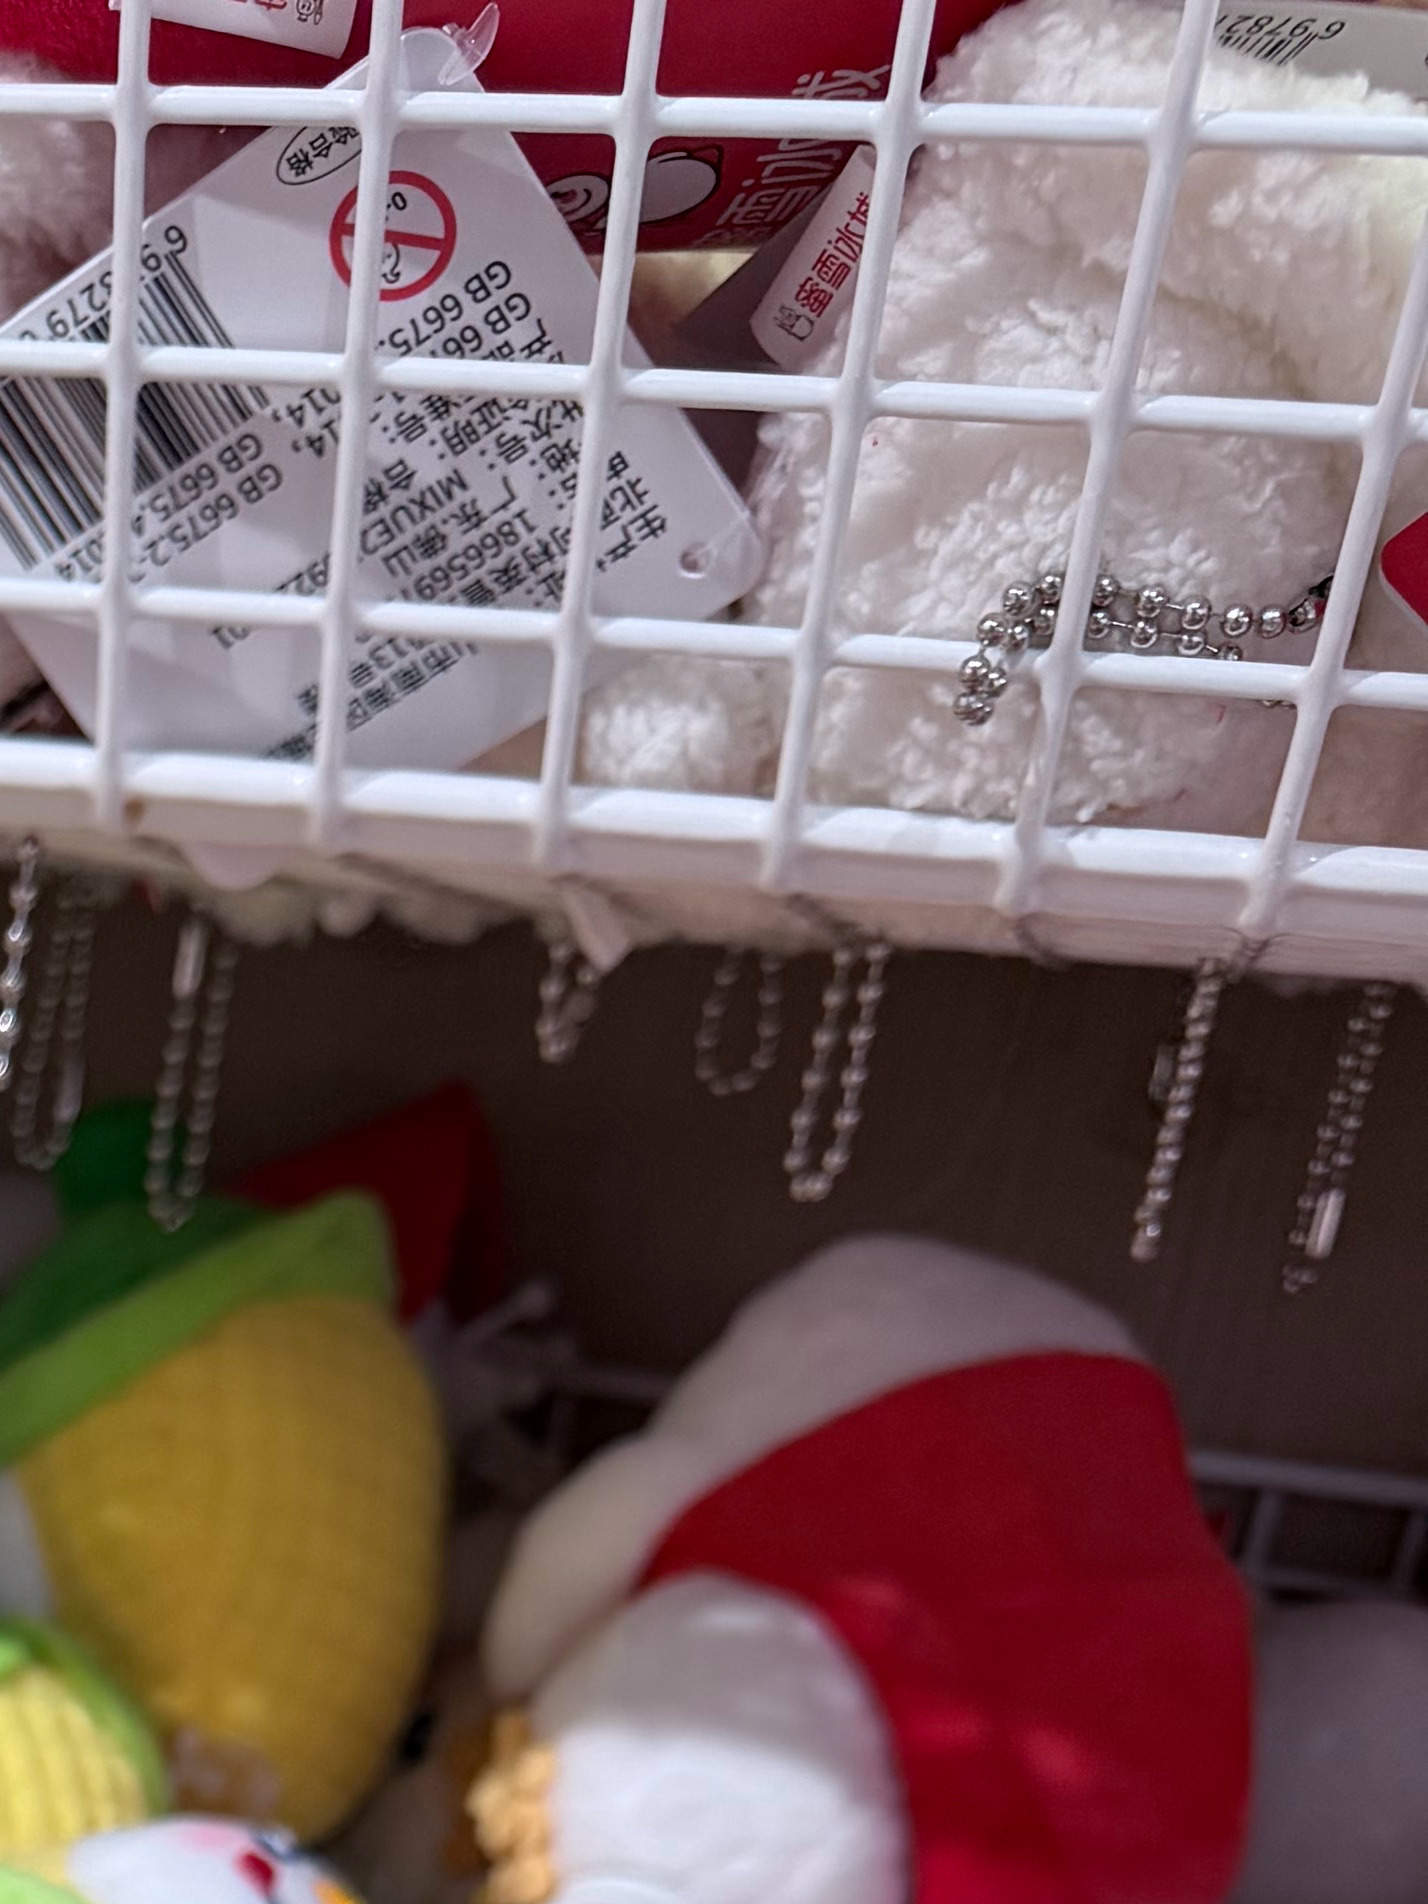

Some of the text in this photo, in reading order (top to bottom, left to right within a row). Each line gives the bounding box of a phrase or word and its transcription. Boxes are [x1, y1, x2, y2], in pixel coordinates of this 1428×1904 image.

[284, 126, 361, 178] 验合格
[462, 258, 512, 304] GB
[482, 290, 533, 335] GB
[215, 431, 263, 475] GB
[234, 462, 282, 505] GB
